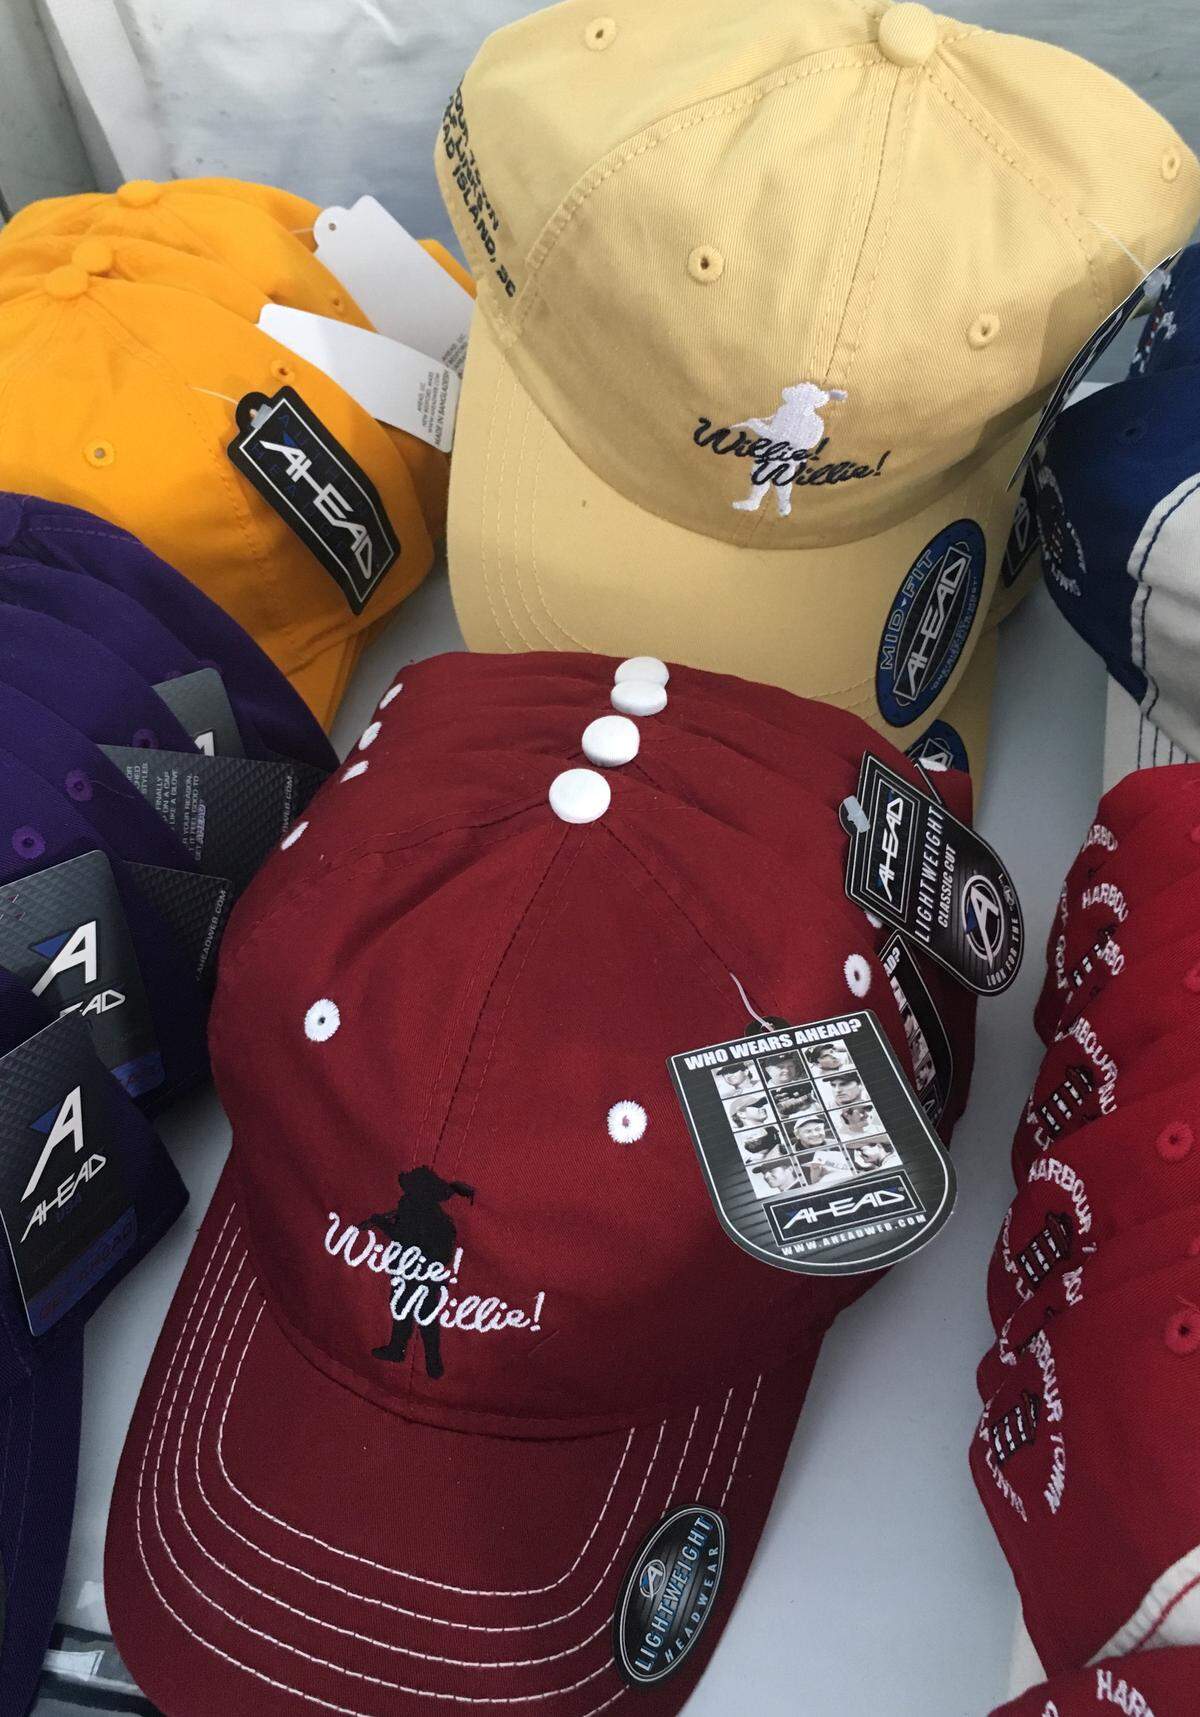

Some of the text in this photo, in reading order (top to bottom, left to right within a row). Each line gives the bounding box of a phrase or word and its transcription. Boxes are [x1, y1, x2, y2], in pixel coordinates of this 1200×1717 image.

[694, 417, 830, 461] Willie!
[751, 451, 891, 486] Willie!
[259, 440, 373, 580] AHEAD
[907, 556, 967, 698] AHEAD
[877, 797, 904, 902] AHEAD
[914, 805, 944, 943] LIGHTWEIGHT
[937, 843, 957, 928] CLASSIC CUT
[684, 1018, 862, 1071] WHO WEARS AHEAD?
[19, 1153, 107, 1243] AHEAD
[781, 1214, 927, 1256] WWW.AHEADWEB.COM
[782, 1189, 906, 1230] AHEAD
[325, 1211, 464, 1284] Willie!
[390, 1276, 546, 1333] Willie!
[634, 1515, 714, 1672] LIGHTWEIGHT
[664, 1546, 719, 1664] HEADWEAR
